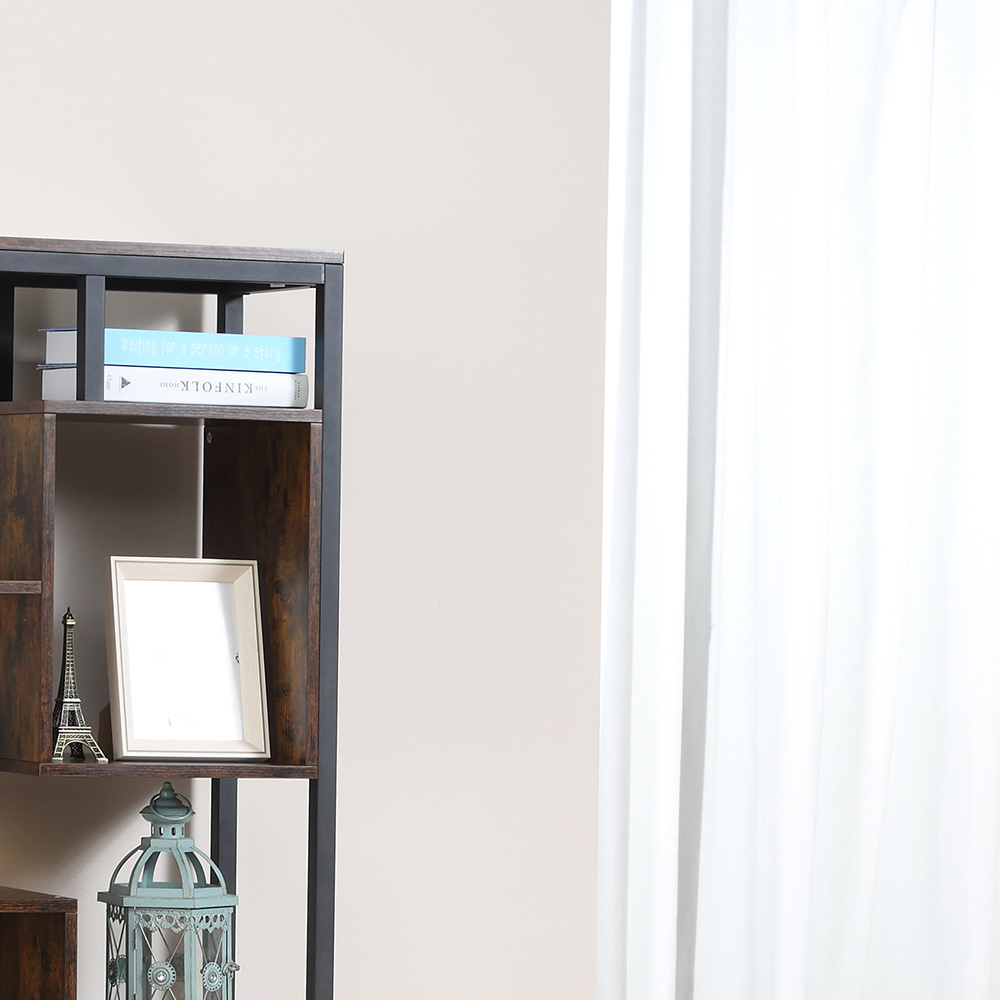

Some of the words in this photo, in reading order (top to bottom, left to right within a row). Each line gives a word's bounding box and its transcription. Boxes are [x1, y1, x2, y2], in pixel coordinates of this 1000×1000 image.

[121, 338, 157, 356] Waiting
[161, 340, 176, 356] for
[181, 342, 187, 355] a
[191, 343, 225, 358] person
[229, 345, 240, 357] or
[244, 345, 250, 358] a
[254, 345, 282, 363] story
[180, 380, 253, 394] KINFOLK
